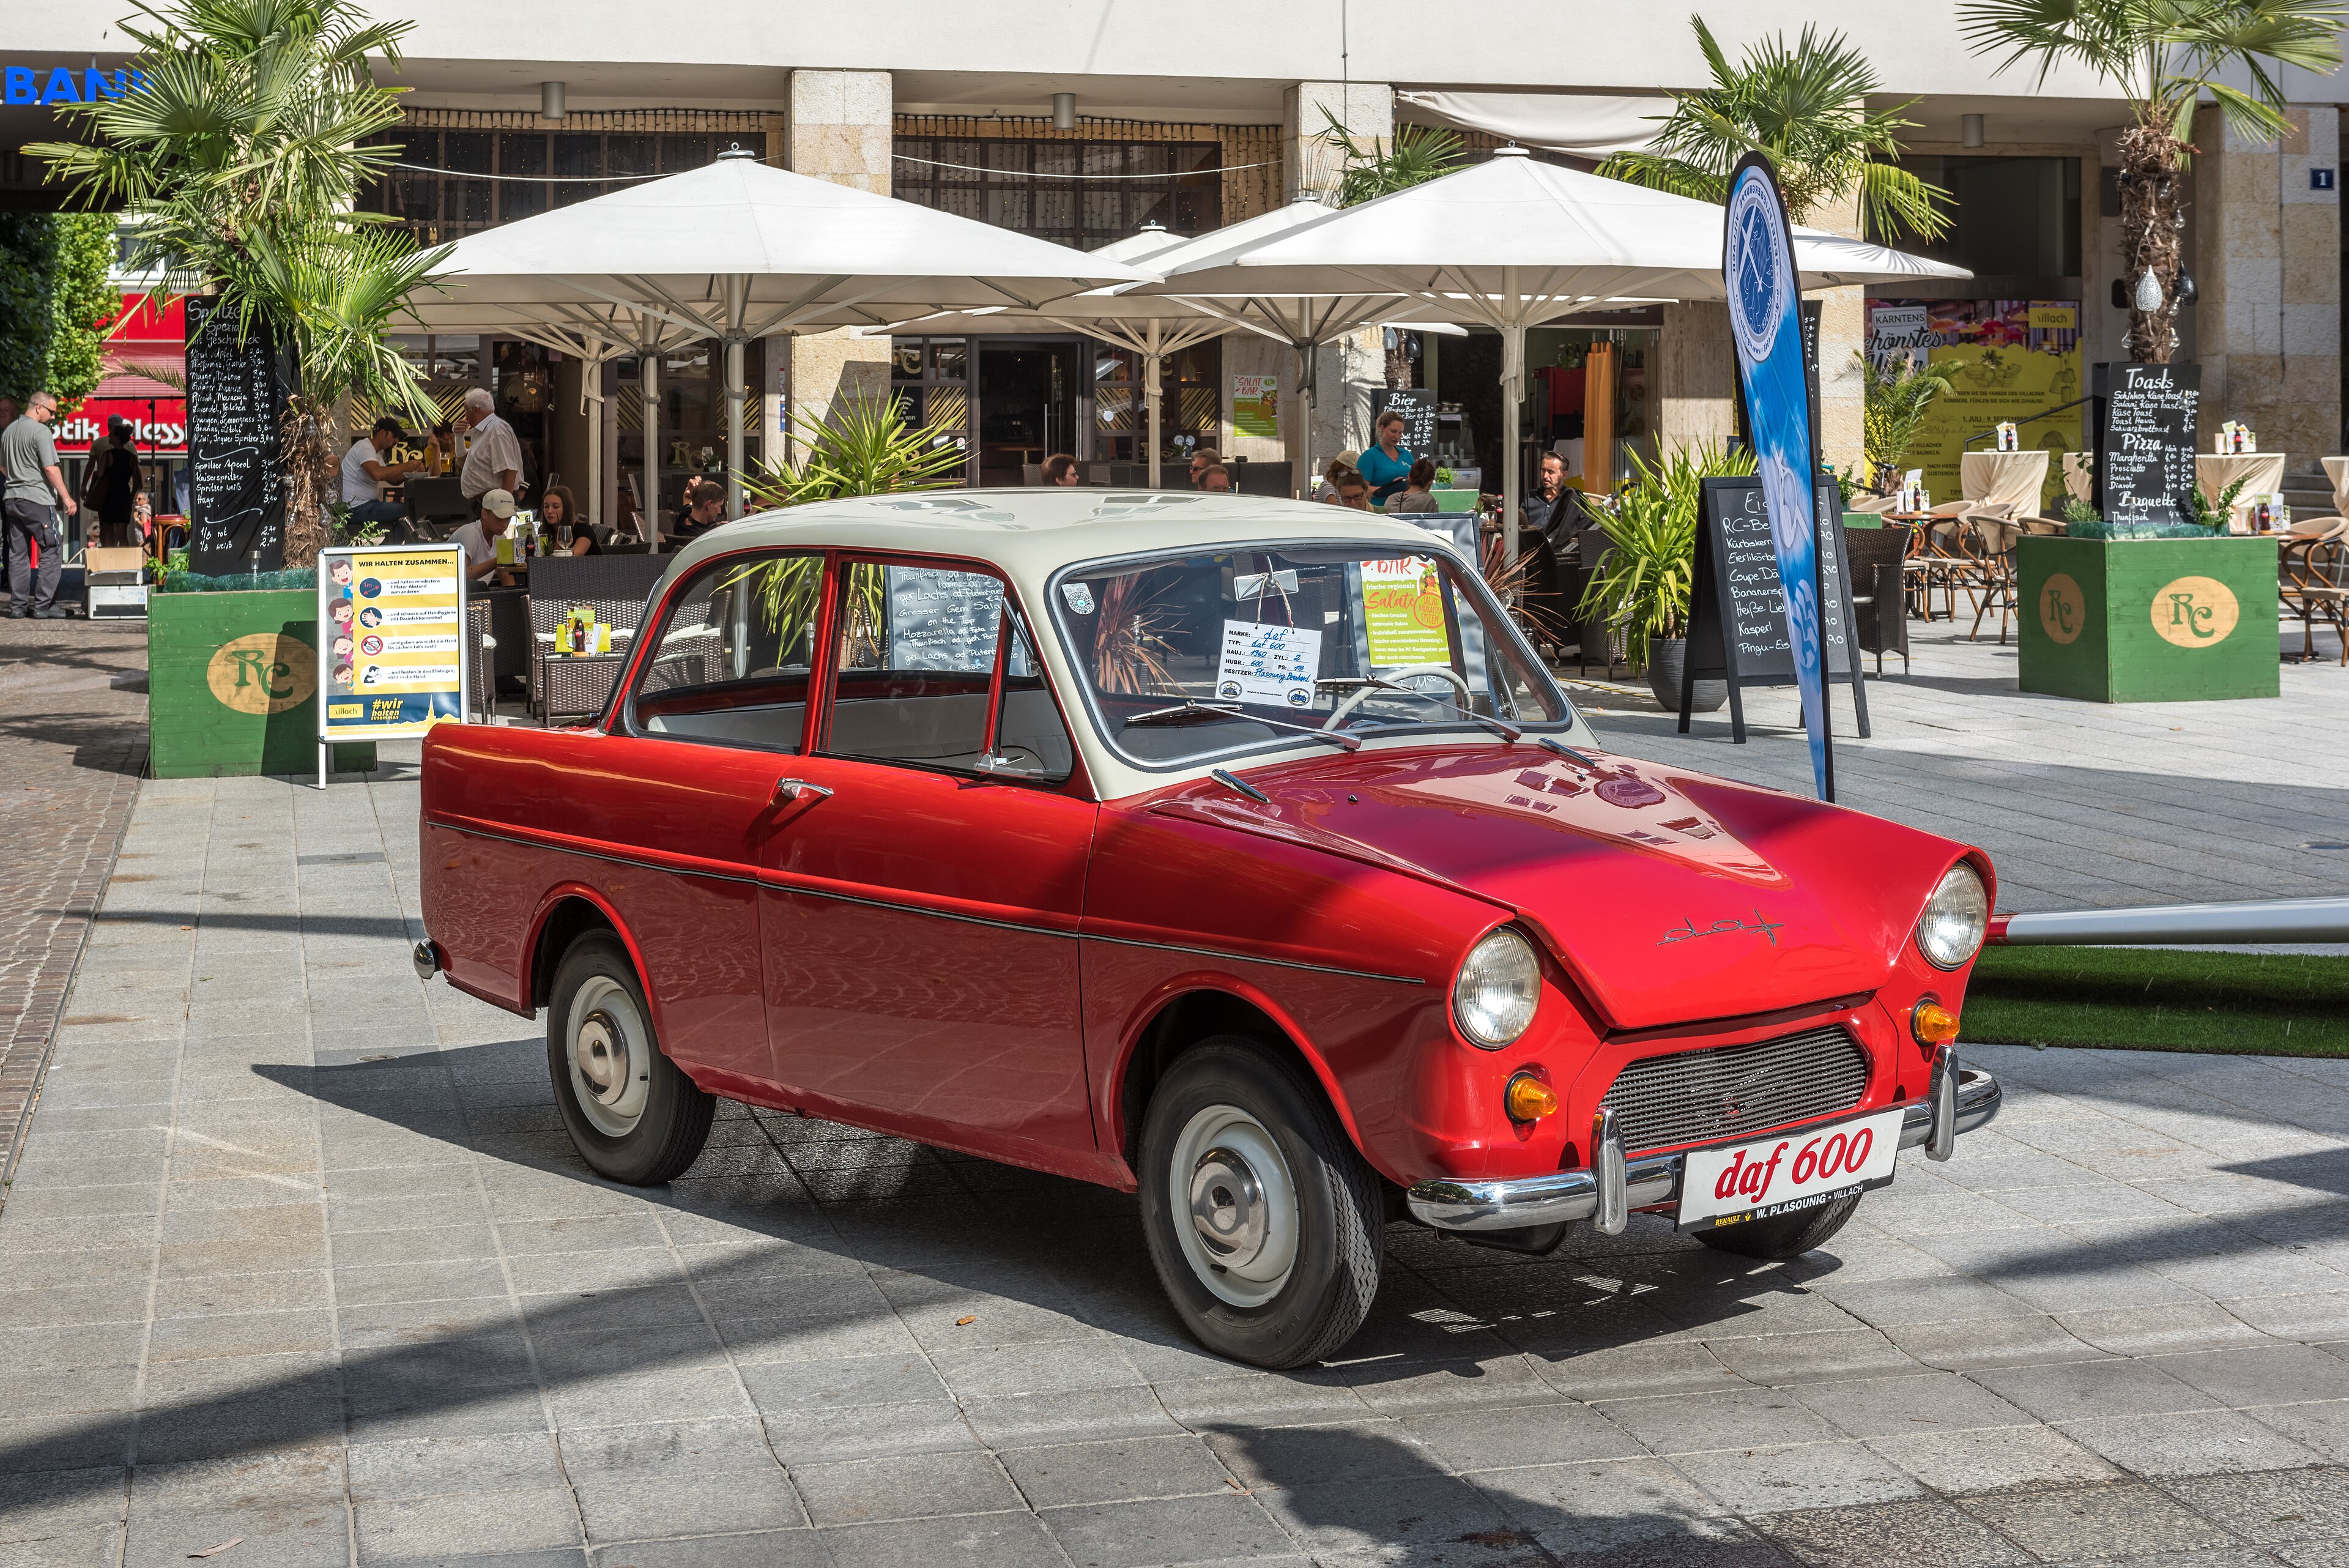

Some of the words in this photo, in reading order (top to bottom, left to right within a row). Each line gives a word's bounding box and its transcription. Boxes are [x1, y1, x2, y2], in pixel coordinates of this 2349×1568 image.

[2319, 172, 2326, 186] 1
[1876, 314, 1924, 324] KÄRNTENS
[216, 371, 240, 381] Melone
[1238, 377, 1263, 386] SALAT
[2126, 368, 2174, 389] Toasts
[1242, 387, 1258, 395] BAR
[2113, 390, 2145, 400] Schinken
[2147, 390, 2164, 399] Käse
[2165, 390, 2183, 399] Toast
[216, 392, 248, 405] Maracuja
[1389, 393, 1417, 406] Bier
[2139, 399, 2158, 409] Käse
[2160, 399, 2179, 409] Toast
[222, 403, 246, 411] Veilchen
[2133, 408, 2153, 417] Toast
[220, 412, 255, 427] Lemongrass
[235, 433, 258, 445] Spritzer
[2121, 433, 2163, 450] Pizza
[2109, 451, 2158, 465] Margheritta
[195, 460, 221, 472] Spritzer
[225, 458, 251, 470] Aperol
[2110, 463, 2146, 473] Prosciutto
[195, 471, 243, 483] Kaiserspritzer
[196, 483, 223, 495] Spritzer
[197, 494, 214, 508] Hugo
[217, 527, 227, 537] rot
[1723, 518, 1771, 535] RC-Be
[216, 540, 232, 550] weiß
[1726, 538, 1773, 549] Kürbiskern
[1728, 552, 1776, 565] Eierlikörbe
[1377, 556, 1412, 574] BAR
[898, 570, 941, 582] Thunfisch
[1729, 569, 1759, 585] Coupe
[1758, 567, 1779, 581] Dä
[937, 578, 981, 589] Parmesan
[917, 588, 948, 600] Lachs
[1364, 590, 1414, 609] Salate
[1423, 596, 1438, 606] SALAT
[899, 608, 940, 617] Grosser
[1735, 601, 1766, 619] Heiße
[2047, 589, 2073, 634] RC
[2168, 593, 2214, 638] RC
[959, 615, 975, 625] Top
[1421, 612, 1439, 624] SYSTEM
[903, 627, 955, 639] Mozzarella
[1263, 628, 1288, 641] daf
[1738, 621, 1772, 637] Kasperl
[910, 638, 946, 647] Thunfisch
[1251, 639, 1267, 647] daf
[1739, 639, 1791, 656] Pingu-Eis
[922, 652, 948, 660] Lachs
[231, 650, 294, 699] RC
[373, 697, 404, 710] #wir
[1714, 1142, 1789, 1203] daf
[1792, 1128, 1873, 1184] 600
[1715, 1214, 1740, 1226] RENAULT
[1756, 1209, 1767, 1219] W.
[1770, 1194, 1827, 1216] PLASOUNIG
[1833, 1184, 1864, 1199] VILLACH
